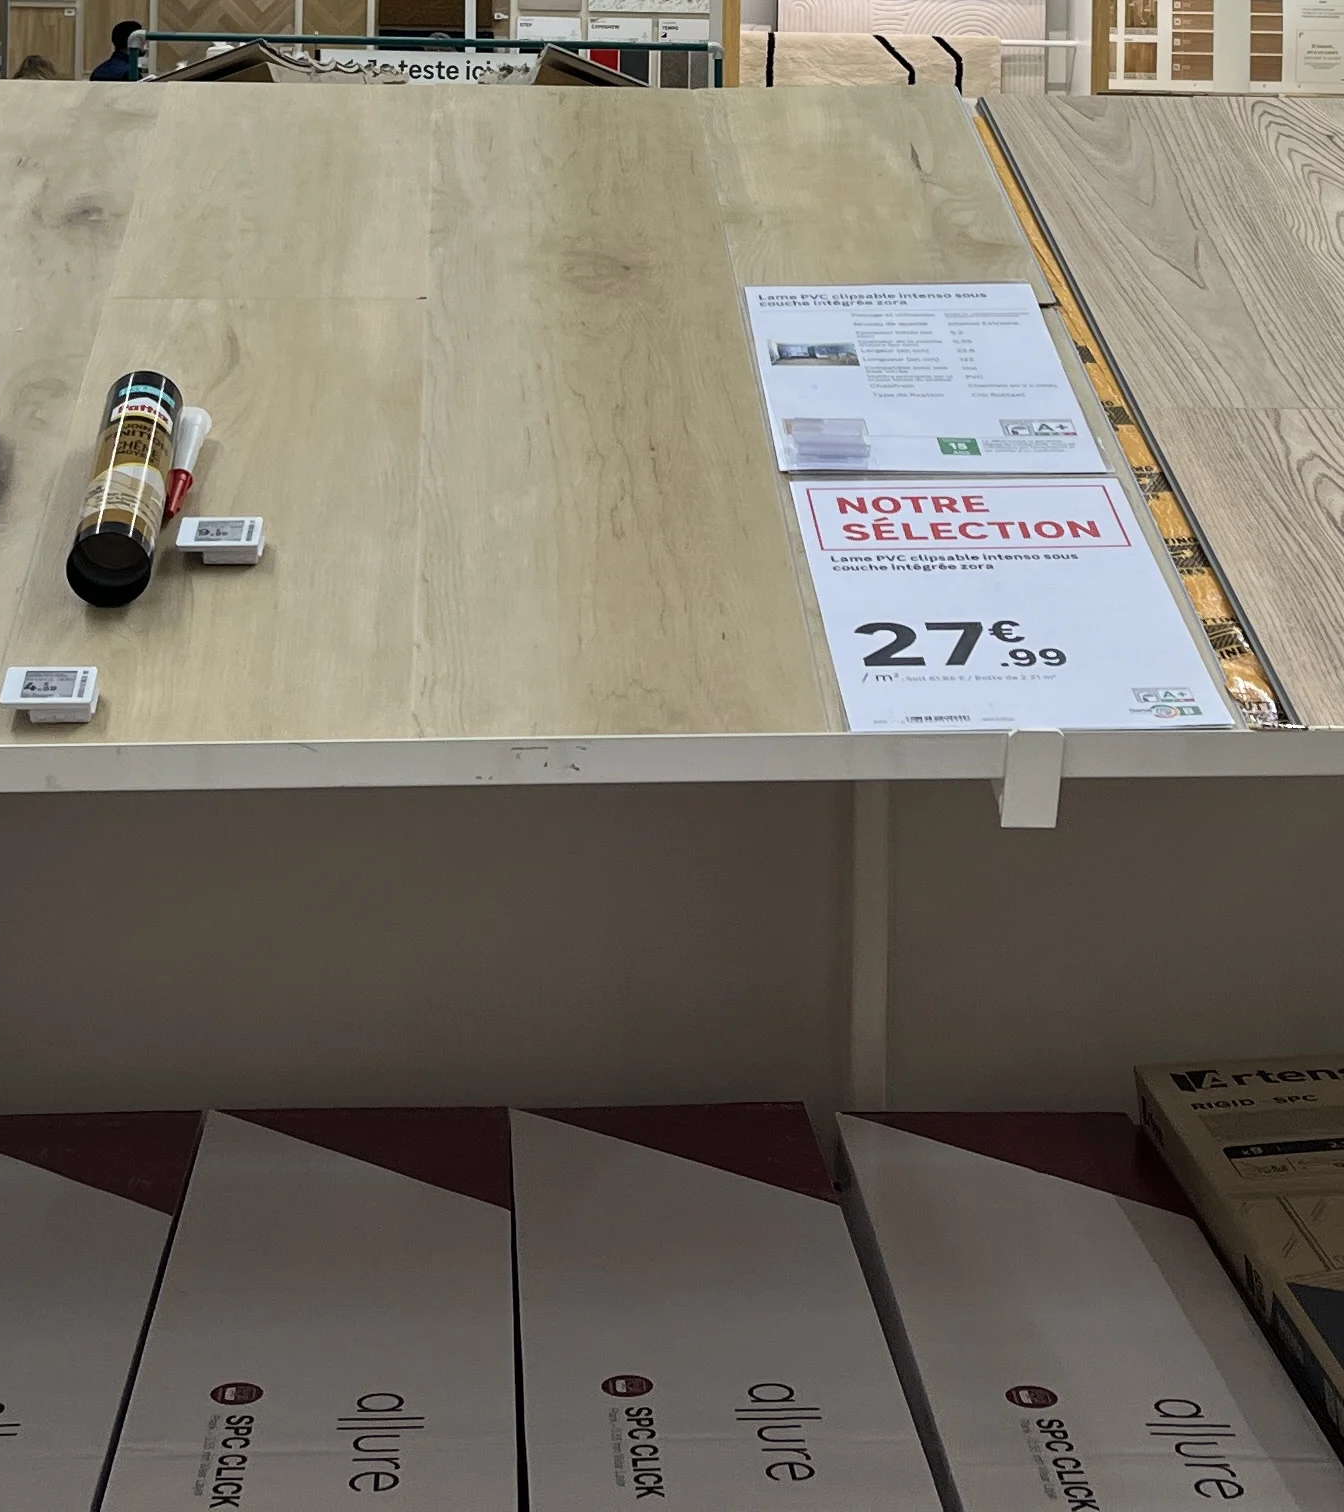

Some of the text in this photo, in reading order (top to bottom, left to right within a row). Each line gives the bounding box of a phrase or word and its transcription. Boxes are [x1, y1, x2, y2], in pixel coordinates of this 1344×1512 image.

[397, 60, 460, 80] teste
[465, 60, 492, 80] ic
[832, 292, 896, 301] clipsable
[836, 495, 990, 514] NOTRE
[842, 516, 1102, 541] SÉLECTION
[832, 563, 889, 571] couche
[891, 561, 957, 572] intégrée
[876, 554, 906, 562] PVC
[910, 552, 979, 563] clipsable
[983, 552, 1041, 560] intenso
[1162, 690, 1187, 698] A+
[1191, 1094, 1318, 1111] RIGID SPC
[336, 1392, 425, 1492] allure
[733, 1382, 823, 1482] allure
[624, 1406, 666, 1500] SPC CLICK
[1145, 1398, 1245, 1500] allure
[209, 1414, 255, 1509] SPC CLICK
[1035, 1417, 1101, 1512] SPC CLICK
